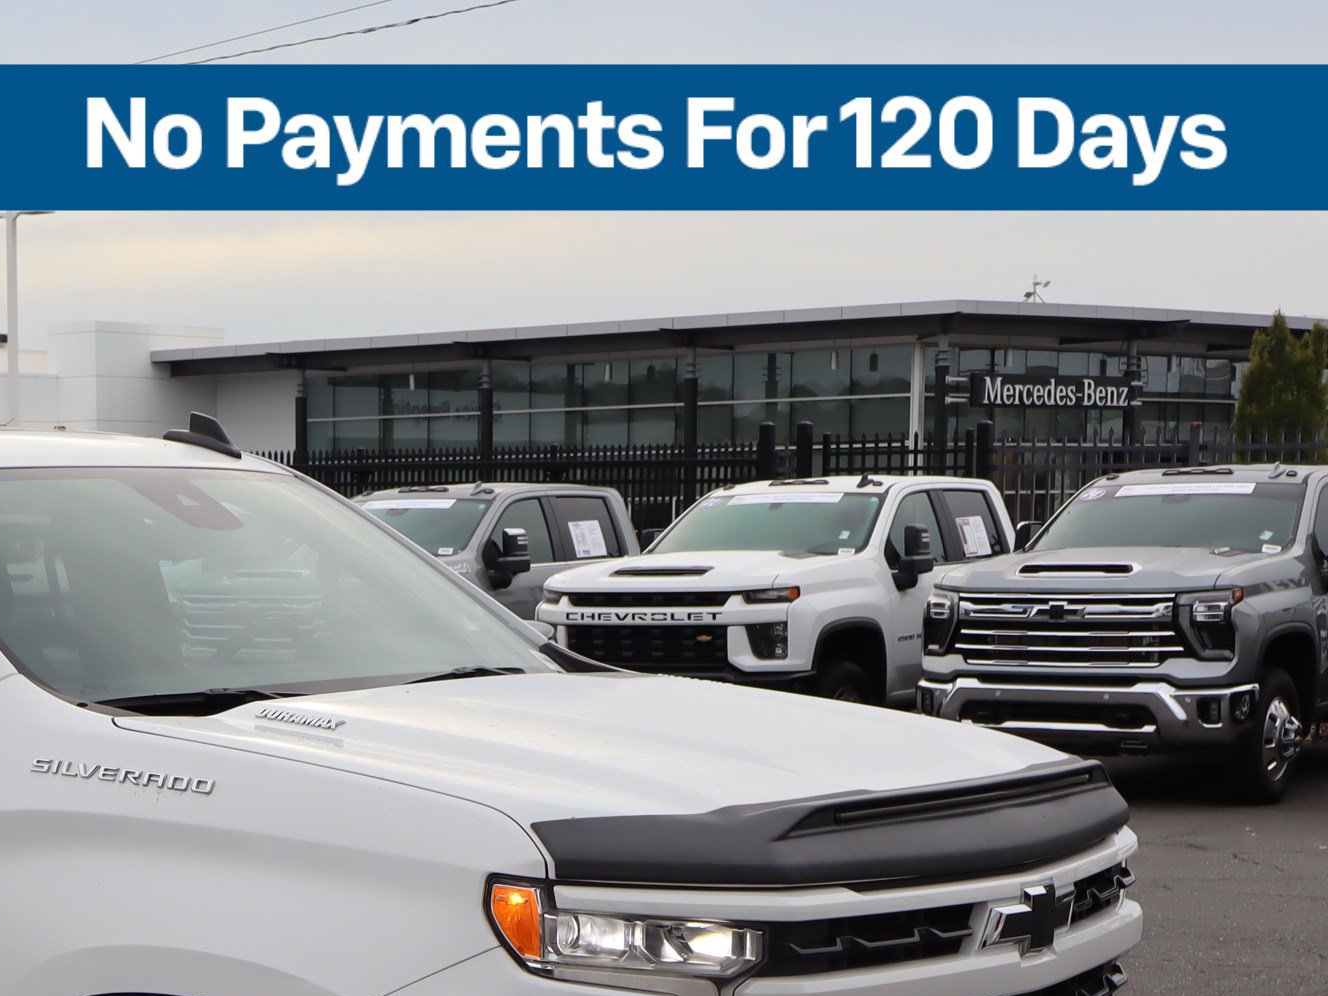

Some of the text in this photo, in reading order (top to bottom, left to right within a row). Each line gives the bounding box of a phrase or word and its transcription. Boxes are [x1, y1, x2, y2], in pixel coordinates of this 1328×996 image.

[983, 376, 1129, 407] Mercedes-Benz
[565, 612, 723, 621] CHEVROLET
[254, 708, 347, 731] DURAMAX
[30, 757, 217, 796] SILVERADO
